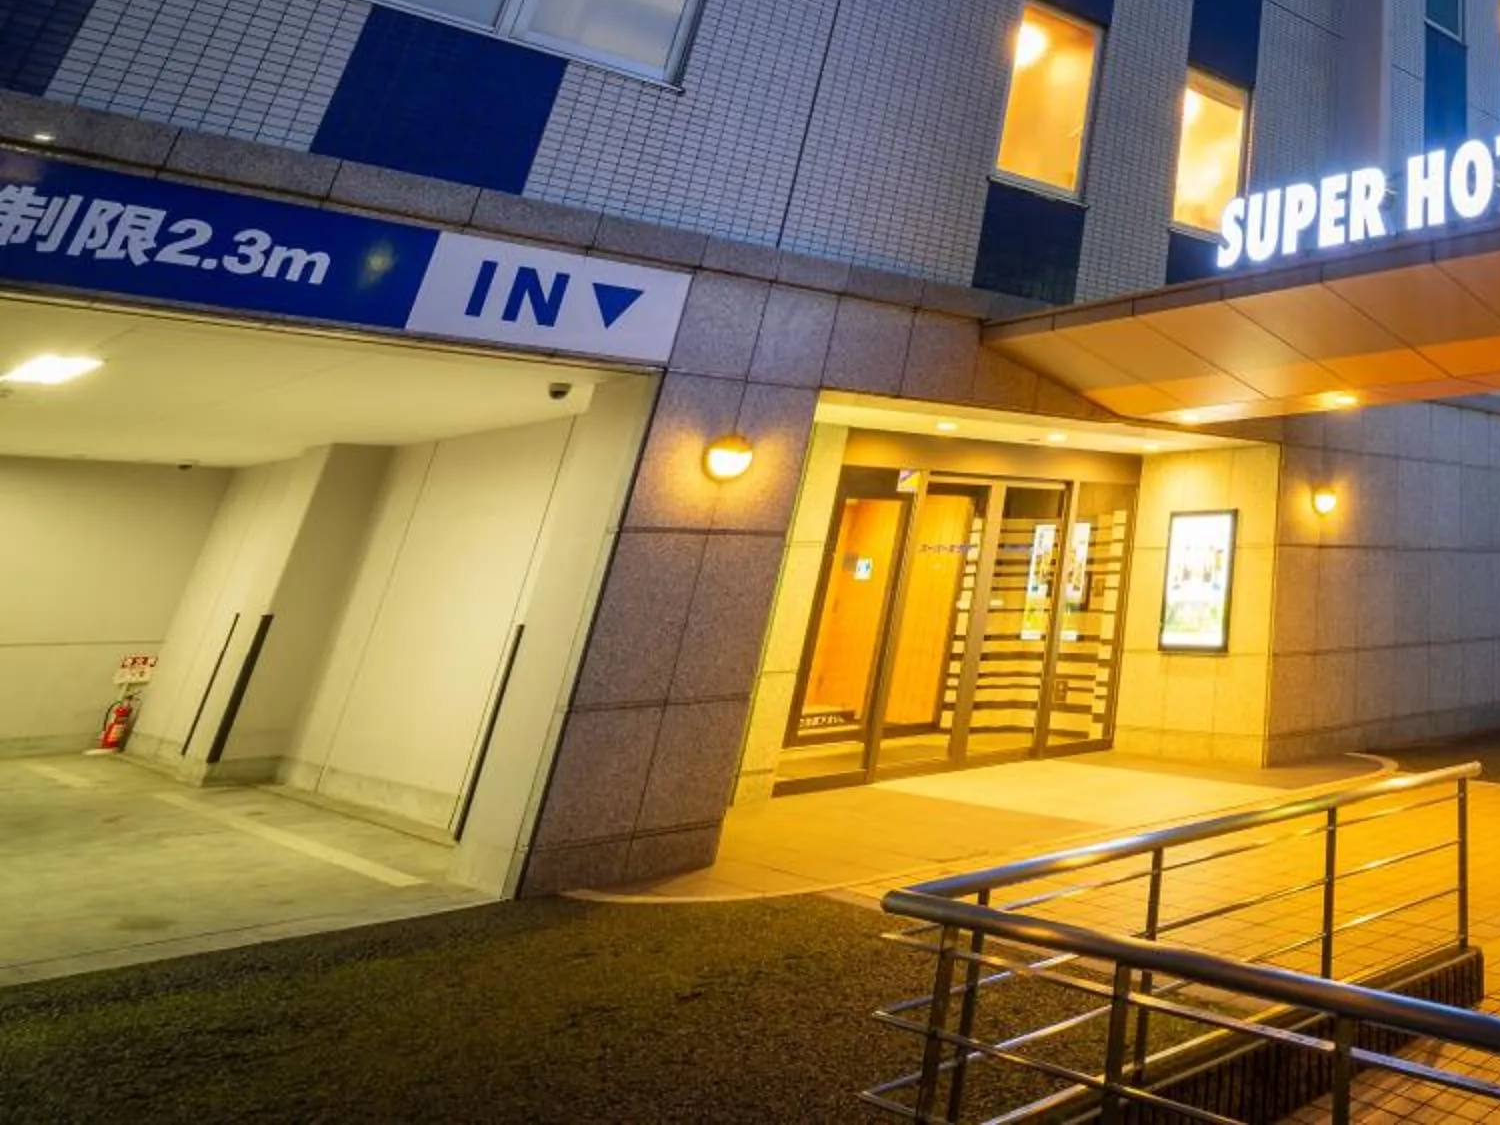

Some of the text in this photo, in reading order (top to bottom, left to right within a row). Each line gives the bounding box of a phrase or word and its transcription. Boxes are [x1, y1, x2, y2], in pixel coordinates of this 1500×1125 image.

[0, 184, 332, 286] 制限2.3m
[1216, 167, 1388, 269] SUPER
[465, 260, 571, 327] IN
